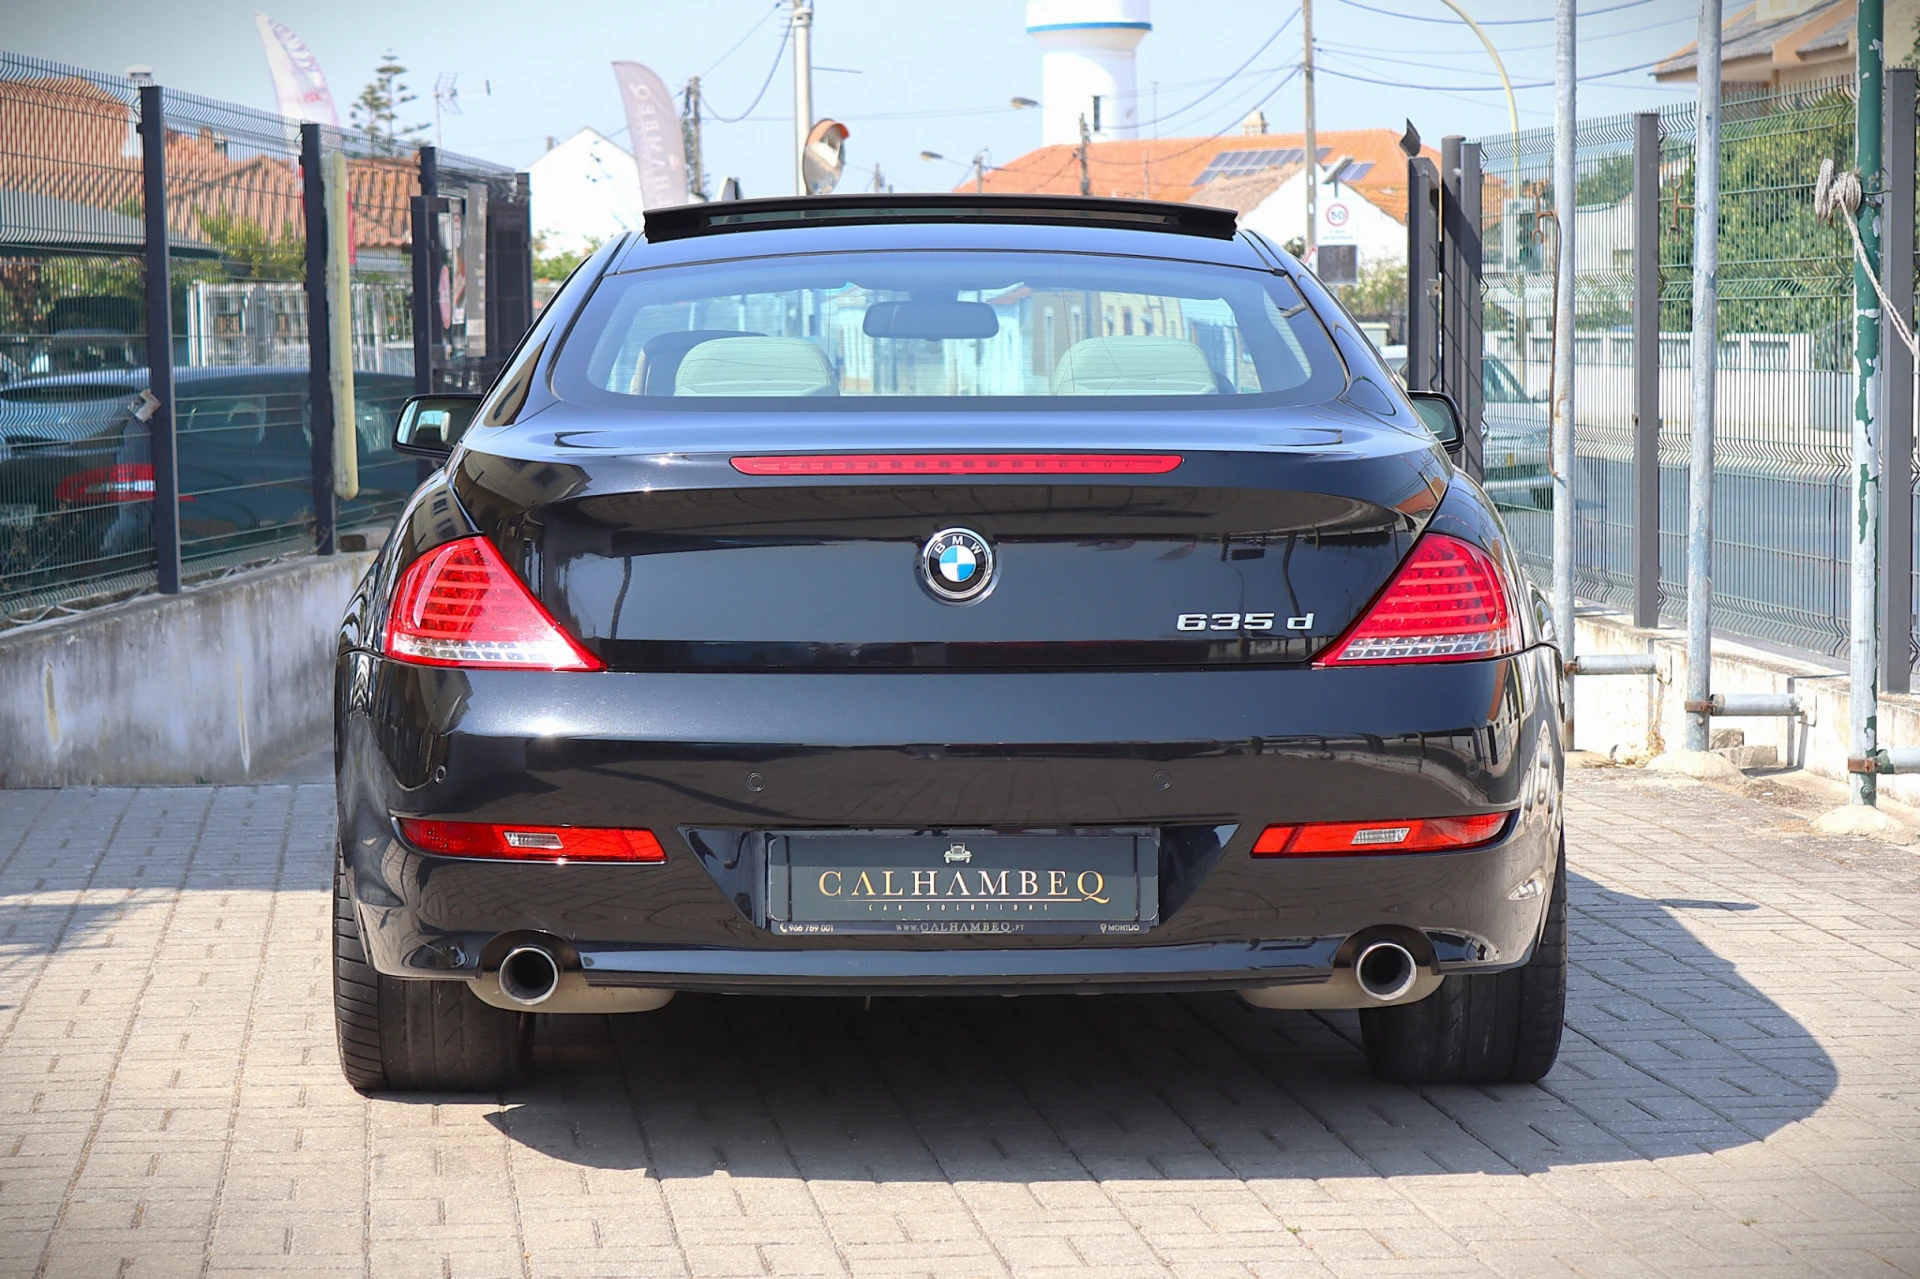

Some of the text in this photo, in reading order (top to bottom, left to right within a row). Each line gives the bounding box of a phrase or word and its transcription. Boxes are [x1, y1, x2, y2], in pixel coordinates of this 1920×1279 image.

[1331, 211, 1345, 220] 50
[934, 535, 983, 554] BMW
[1177, 613, 1315, 631] 635 d
[818, 870, 1110, 904] CALHAMBEQ
[868, 903, 1049, 912] CAR SOLUTIONS
